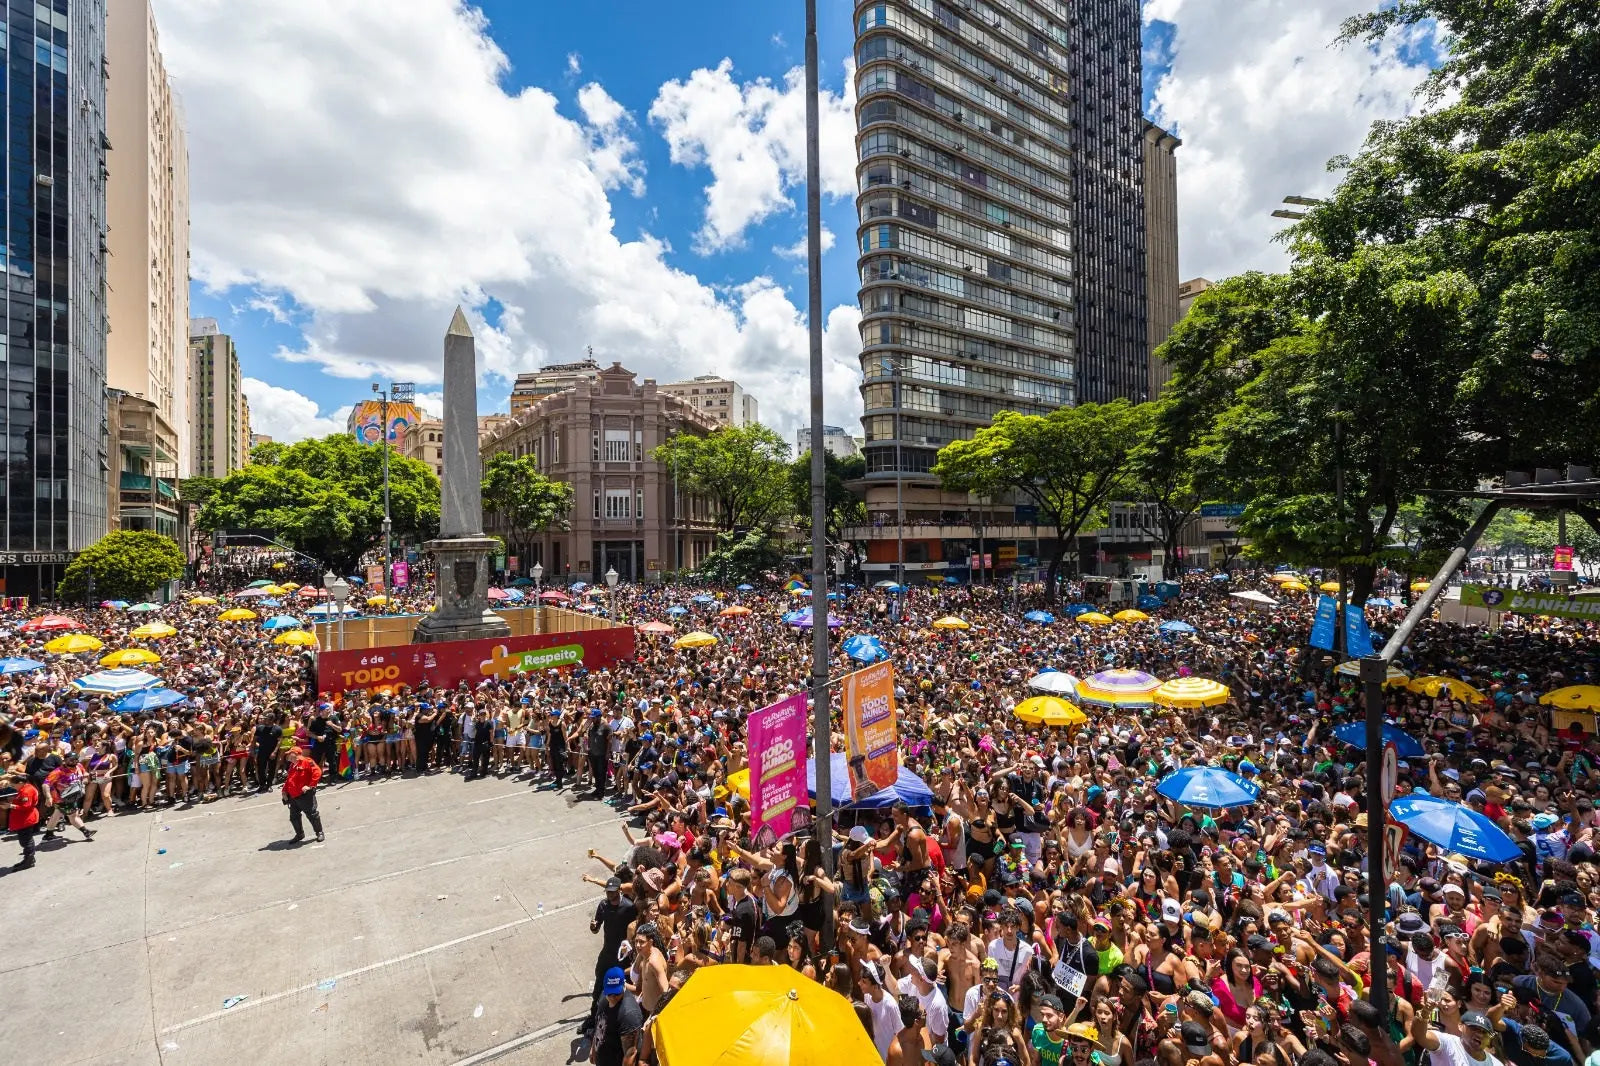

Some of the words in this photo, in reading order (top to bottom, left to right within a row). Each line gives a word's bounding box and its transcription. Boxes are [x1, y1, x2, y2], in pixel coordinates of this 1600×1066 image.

[23, 553, 74, 564] GUERRA
[1510, 595, 1600, 615] BANHEIR
[360, 656, 368, 666] é
[370, 655, 385, 664] de
[524, 649, 577, 666] Respeito
[341, 664, 400, 686] TODO
[862, 694, 888, 713] TODO
[862, 703, 889, 721] MUNDO
[760, 738, 793, 762] TODO
[762, 750, 795, 775] MUNDO
[769, 789, 791, 806] FELIZ
[732, 926, 742, 937] 12
